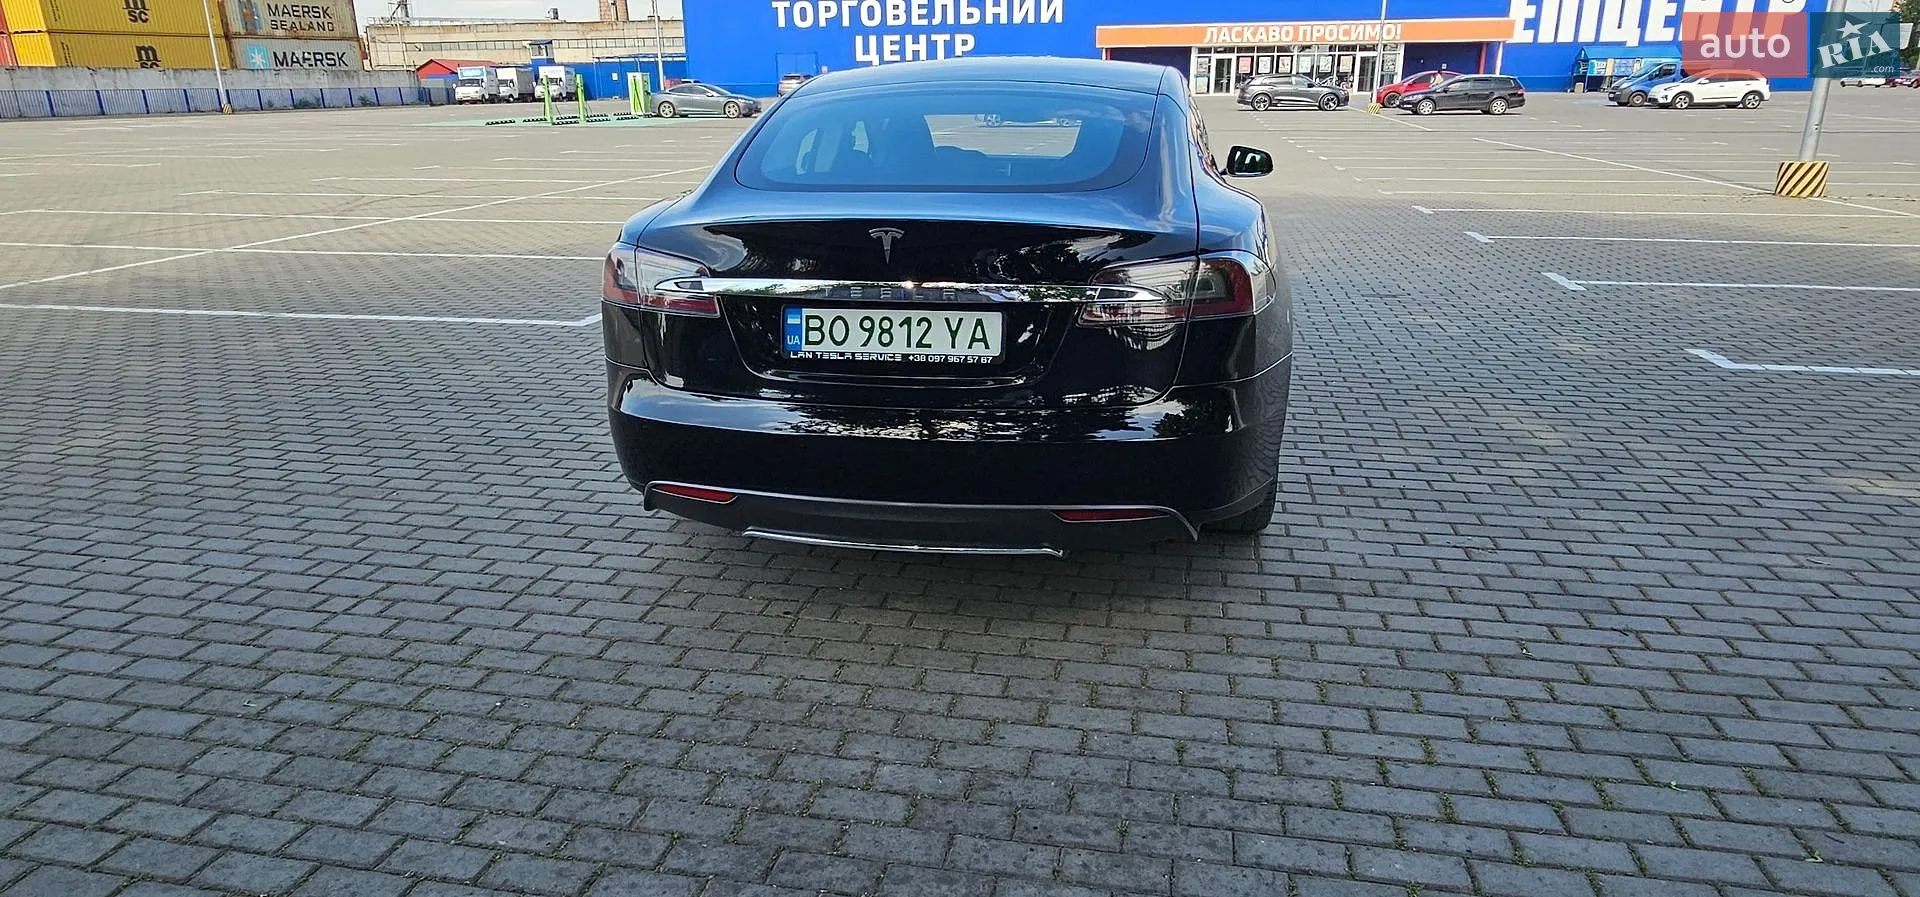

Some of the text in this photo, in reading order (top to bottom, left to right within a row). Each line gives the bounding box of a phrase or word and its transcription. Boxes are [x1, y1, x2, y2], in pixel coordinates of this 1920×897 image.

[267, 3, 333, 19] MAERSK
[270, 19, 335, 32] SEALAND
[1203, 23, 1402, 43] ЛАСКАВО ПРОСИМО!
[855, 33, 976, 66] ЦЕНТР
[272, 51, 349, 68] MAERSK
[787, 335, 801, 345] UA
[804, 314, 991, 350] BO 9812 YA
[790, 351, 813, 359] LAN
[815, 352, 853, 360] TESLA
[854, 353, 903, 362] SERVICE
[908, 354, 926, 363] +38
[927, 354, 946, 363] 097
[947, 355, 966, 364] 967
[967, 356, 979, 364] 57
